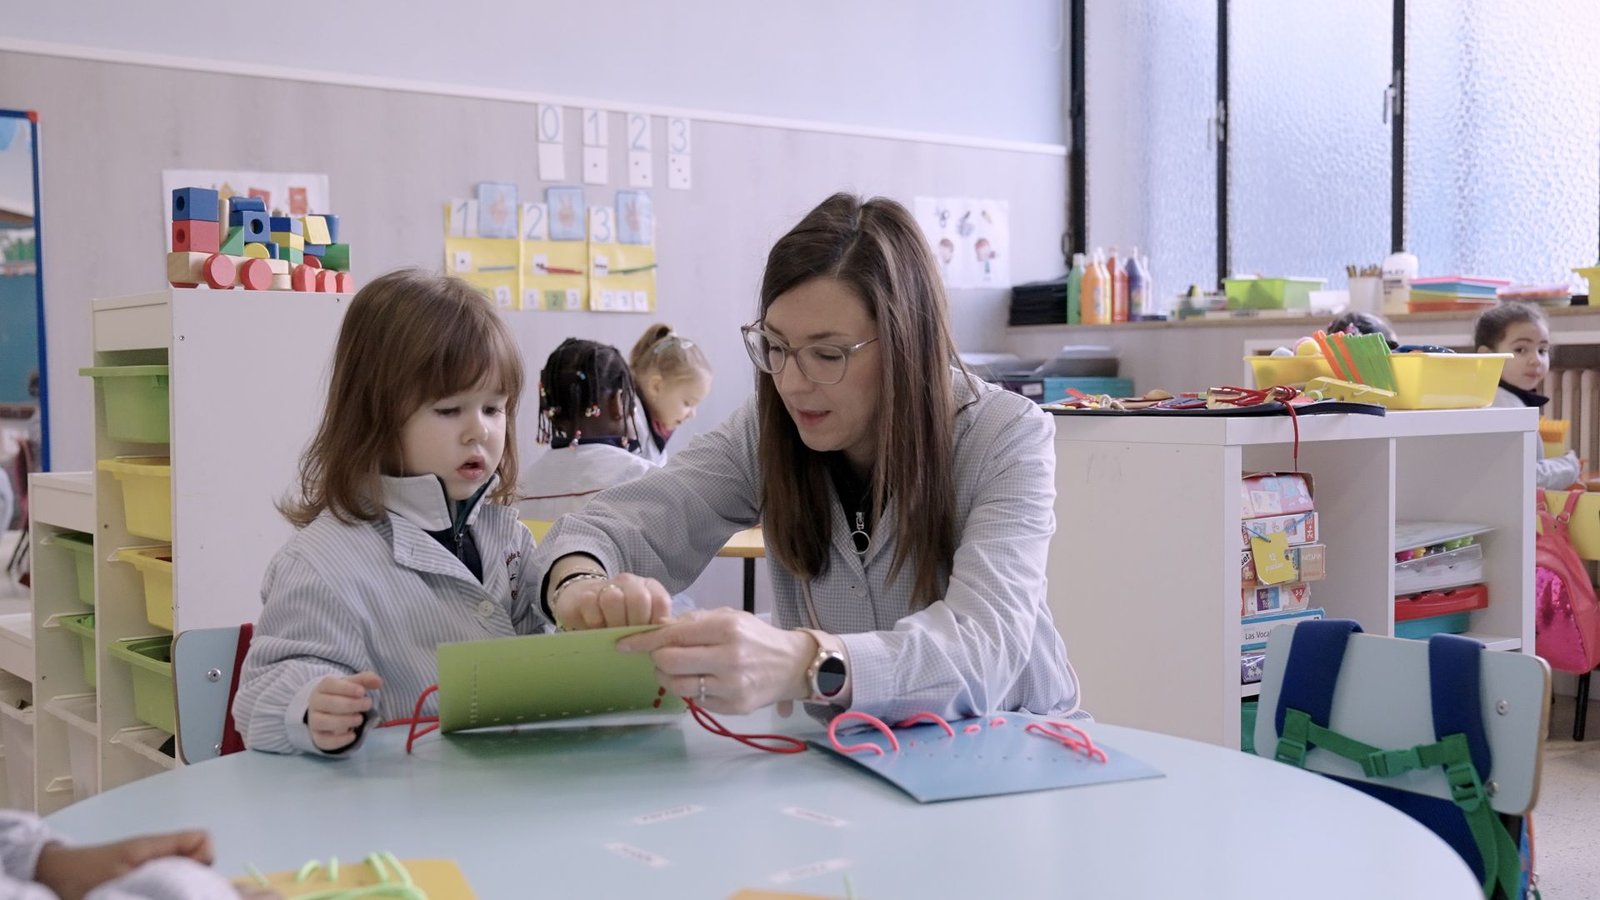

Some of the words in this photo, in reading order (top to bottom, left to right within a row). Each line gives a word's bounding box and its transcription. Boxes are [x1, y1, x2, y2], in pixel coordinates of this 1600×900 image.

[541, 105, 560, 142] 0
[588, 111, 600, 145] 1
[630, 115, 648, 151] 2
[671, 119, 688, 153] 3
[456, 201, 469, 237] 1
[526, 205, 544, 240] 2
[593, 208, 611, 243] 3
[552, 293, 558, 306] 2
[1245, 632, 1255, 640] Las
